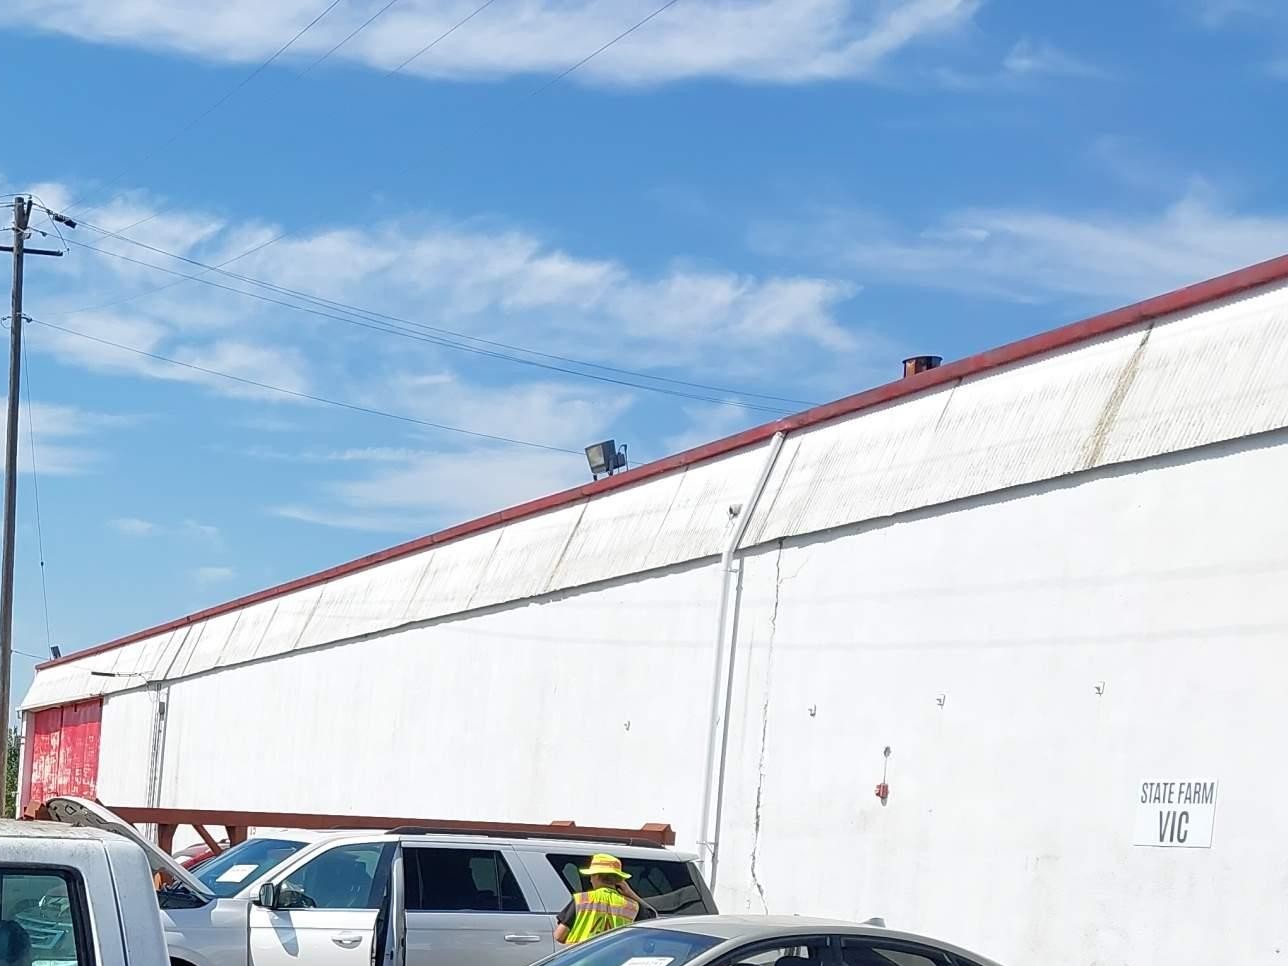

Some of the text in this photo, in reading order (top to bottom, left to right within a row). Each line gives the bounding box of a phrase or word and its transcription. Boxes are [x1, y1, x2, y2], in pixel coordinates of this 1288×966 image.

[1140, 782, 1215, 804] STATE FARM
[1159, 810, 1190, 843] VIC
